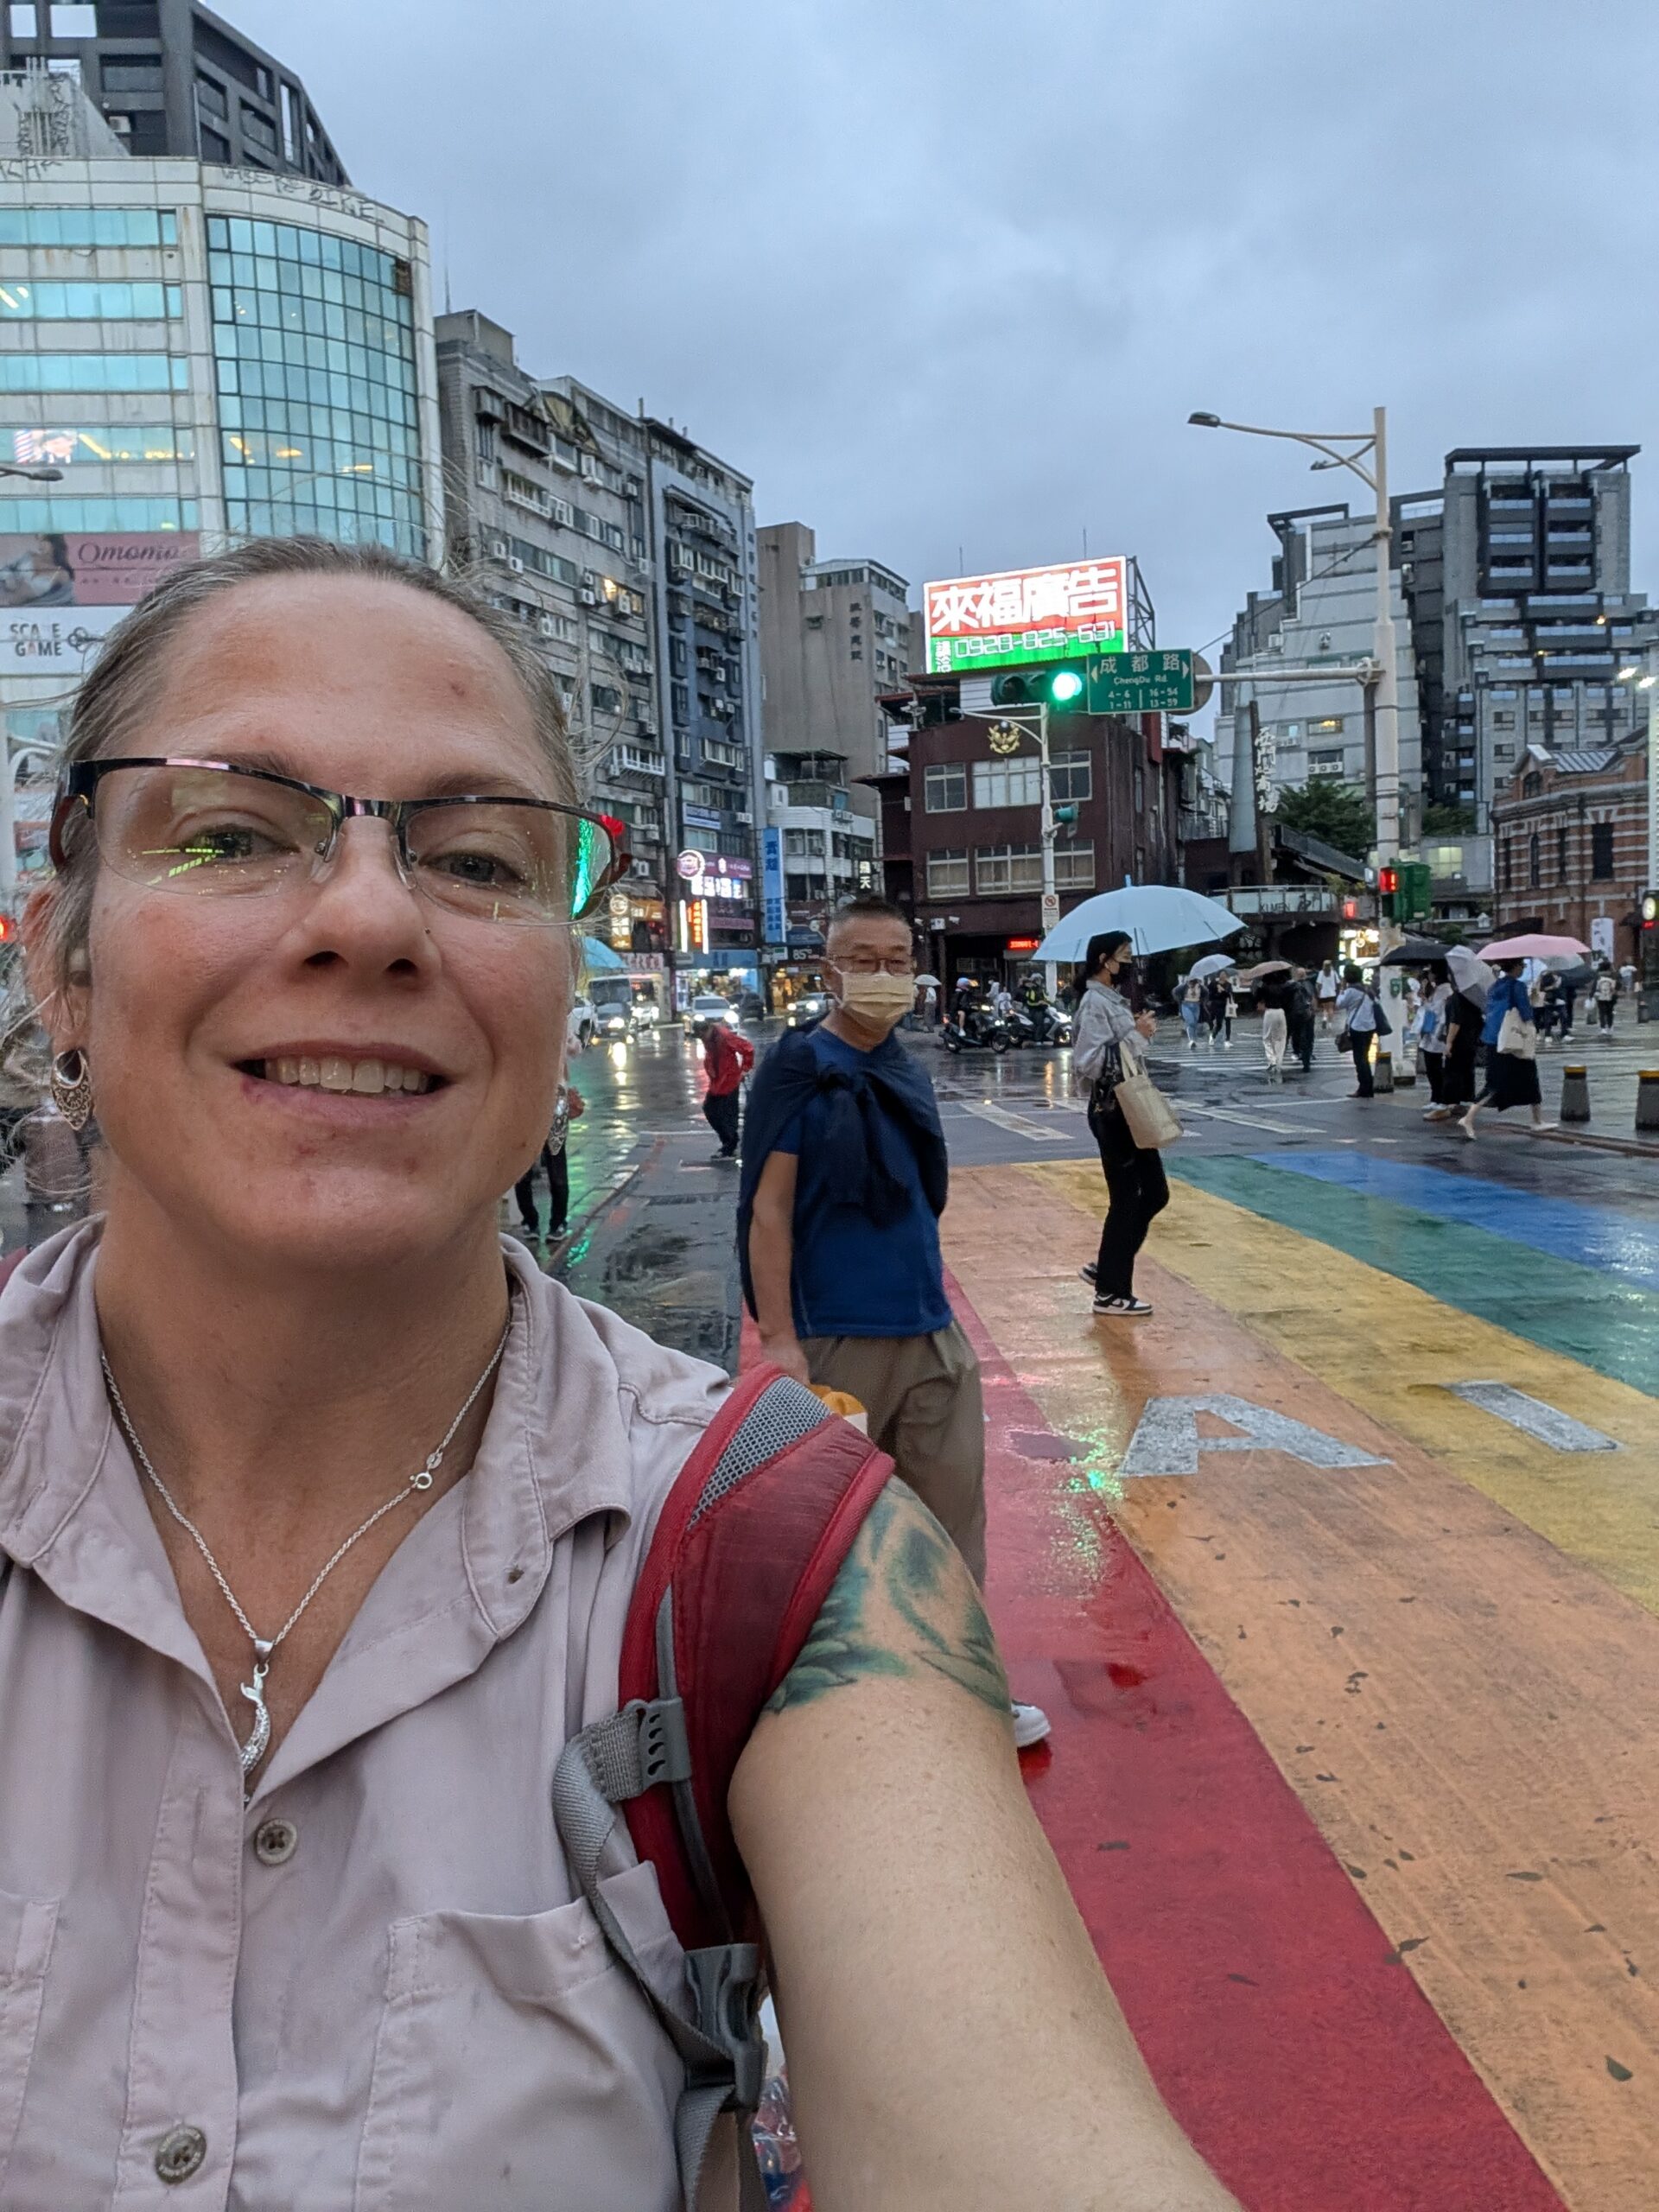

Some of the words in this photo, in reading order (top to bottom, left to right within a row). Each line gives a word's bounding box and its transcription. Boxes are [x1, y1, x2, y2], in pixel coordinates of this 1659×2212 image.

[931, 567, 1118, 633] 來福廣告
[16, 641, 62, 657] GAME
[955, 620, 1116, 658] 0928-825-631
[1100, 653, 1180, 674] 成都路
[1113, 676, 1151, 685] ChengDu
